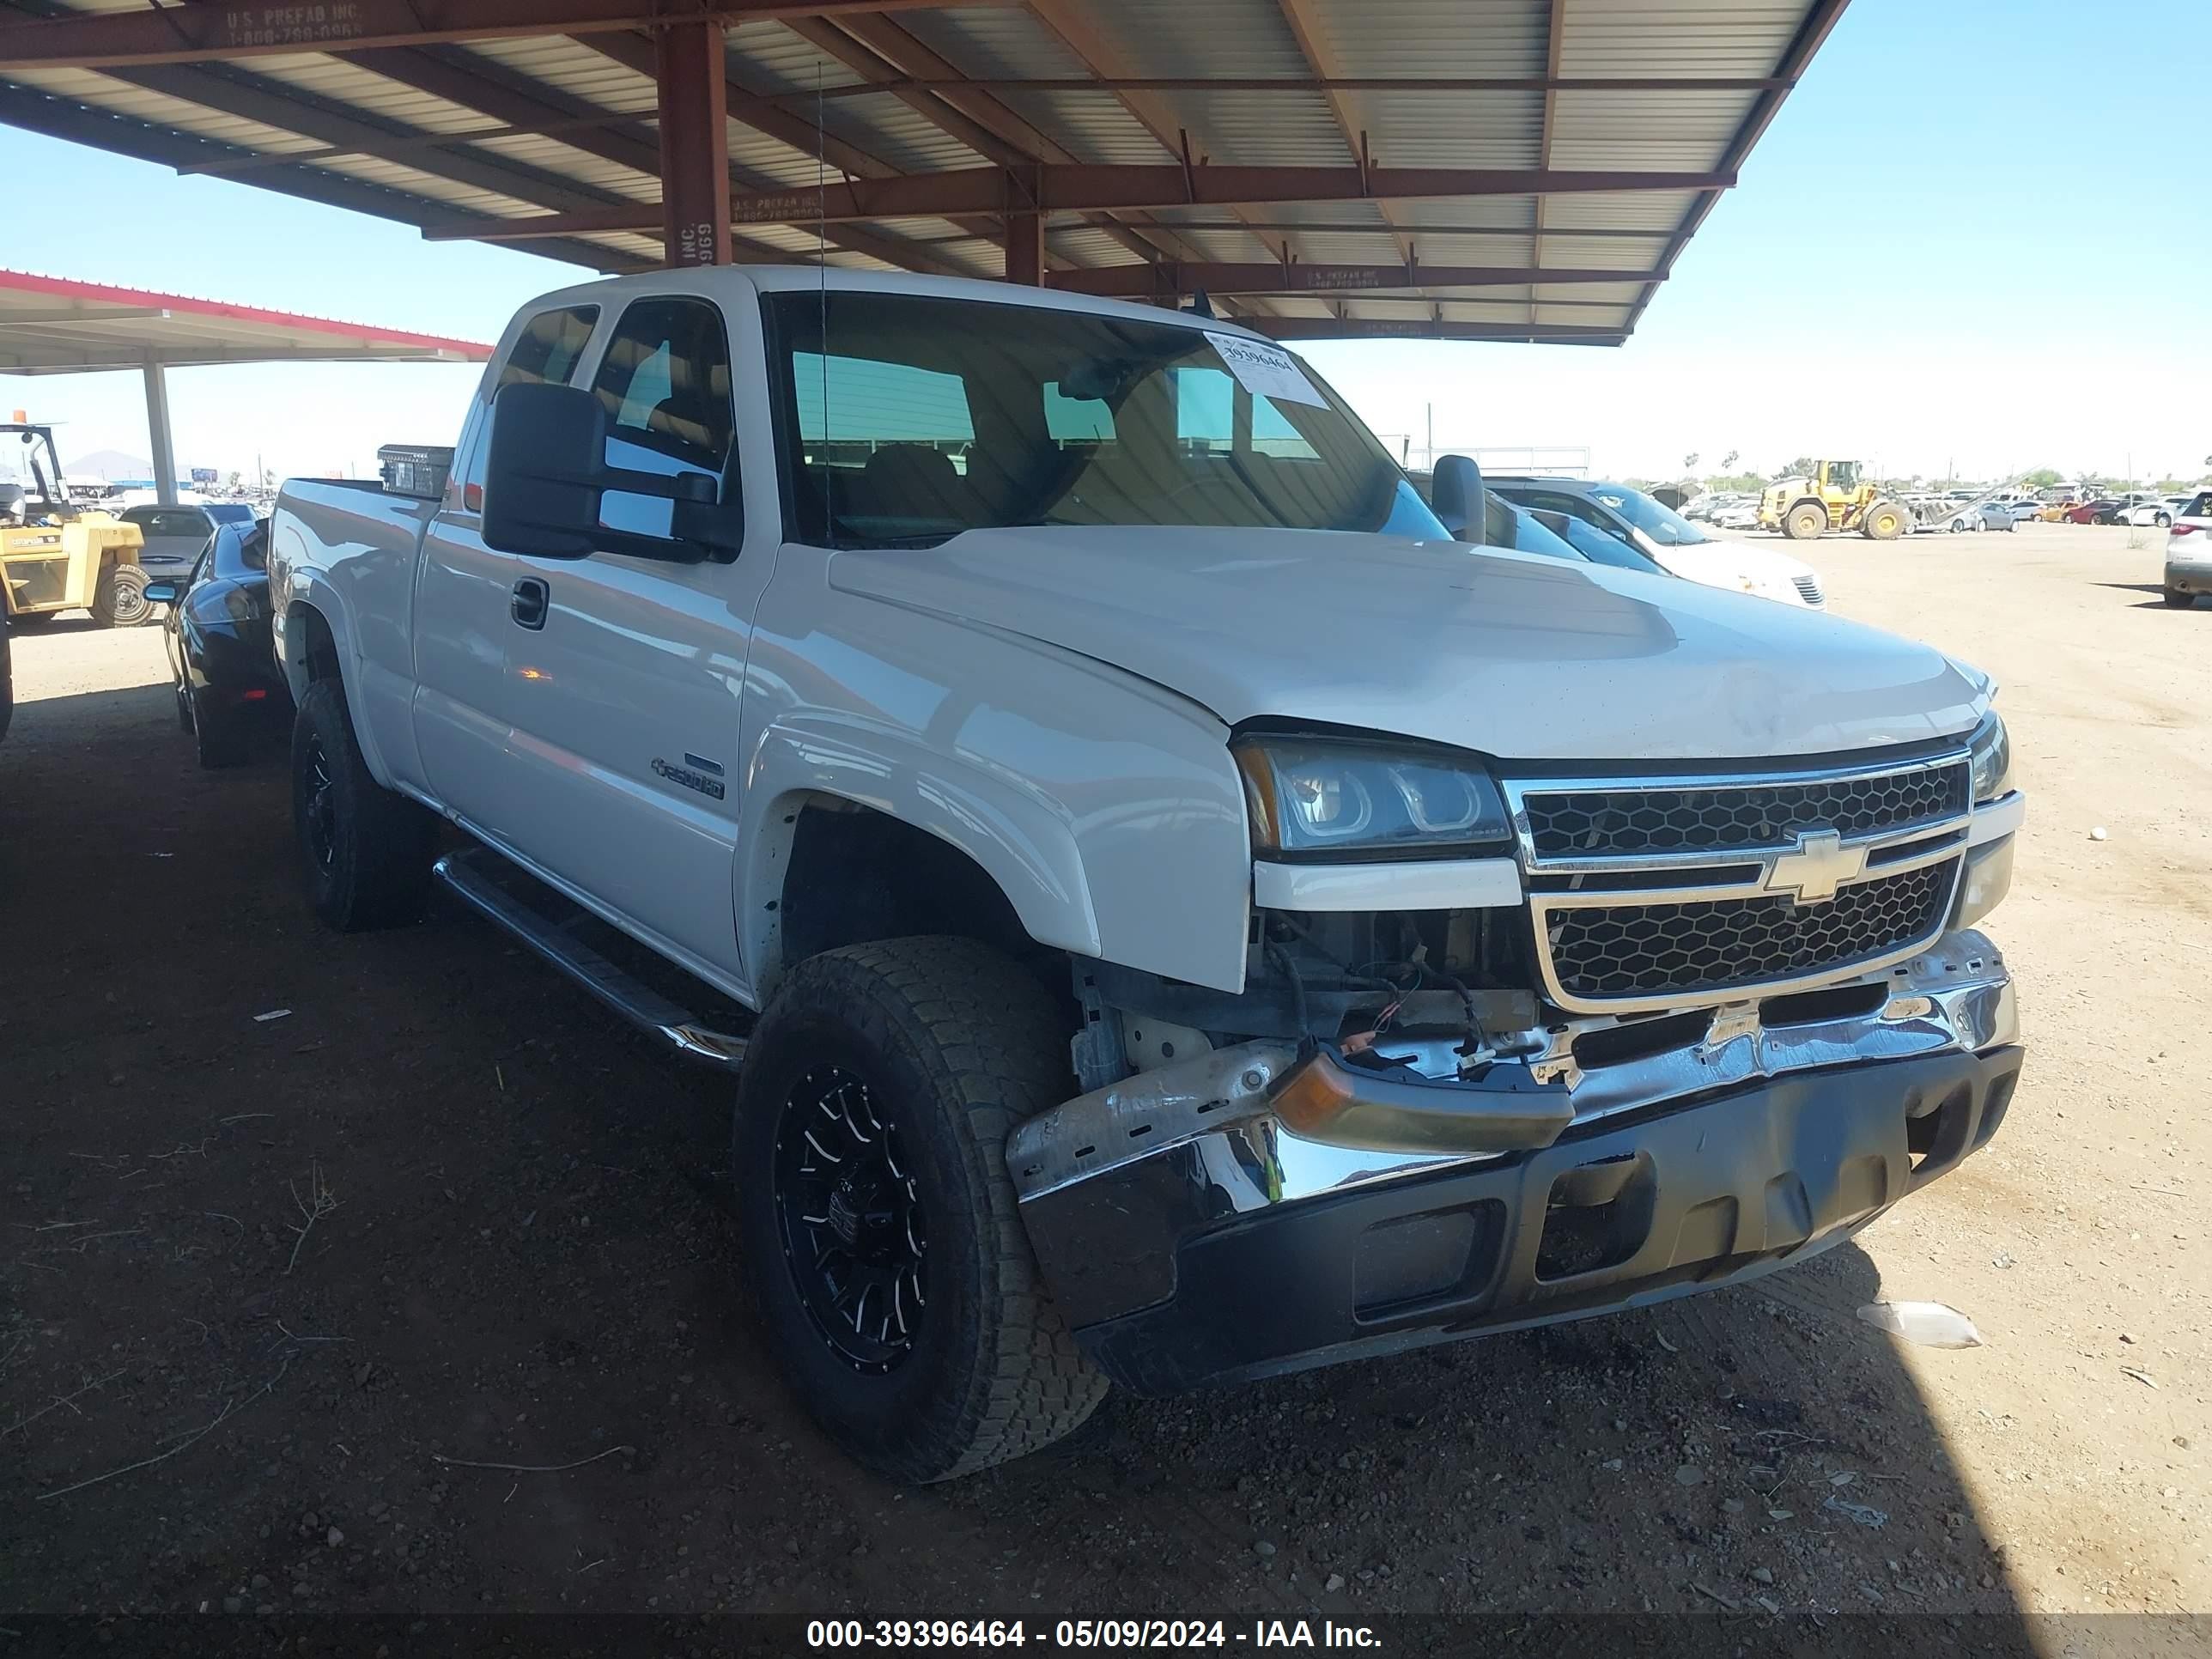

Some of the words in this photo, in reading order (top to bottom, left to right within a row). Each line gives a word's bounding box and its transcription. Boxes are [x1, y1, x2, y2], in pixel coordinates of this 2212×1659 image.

[264, 5, 326, 27] PREFAB
[681, 222, 696, 258] INC.
[697, 223, 714, 267] 969
[1223, 346, 1293, 373] 39396464
